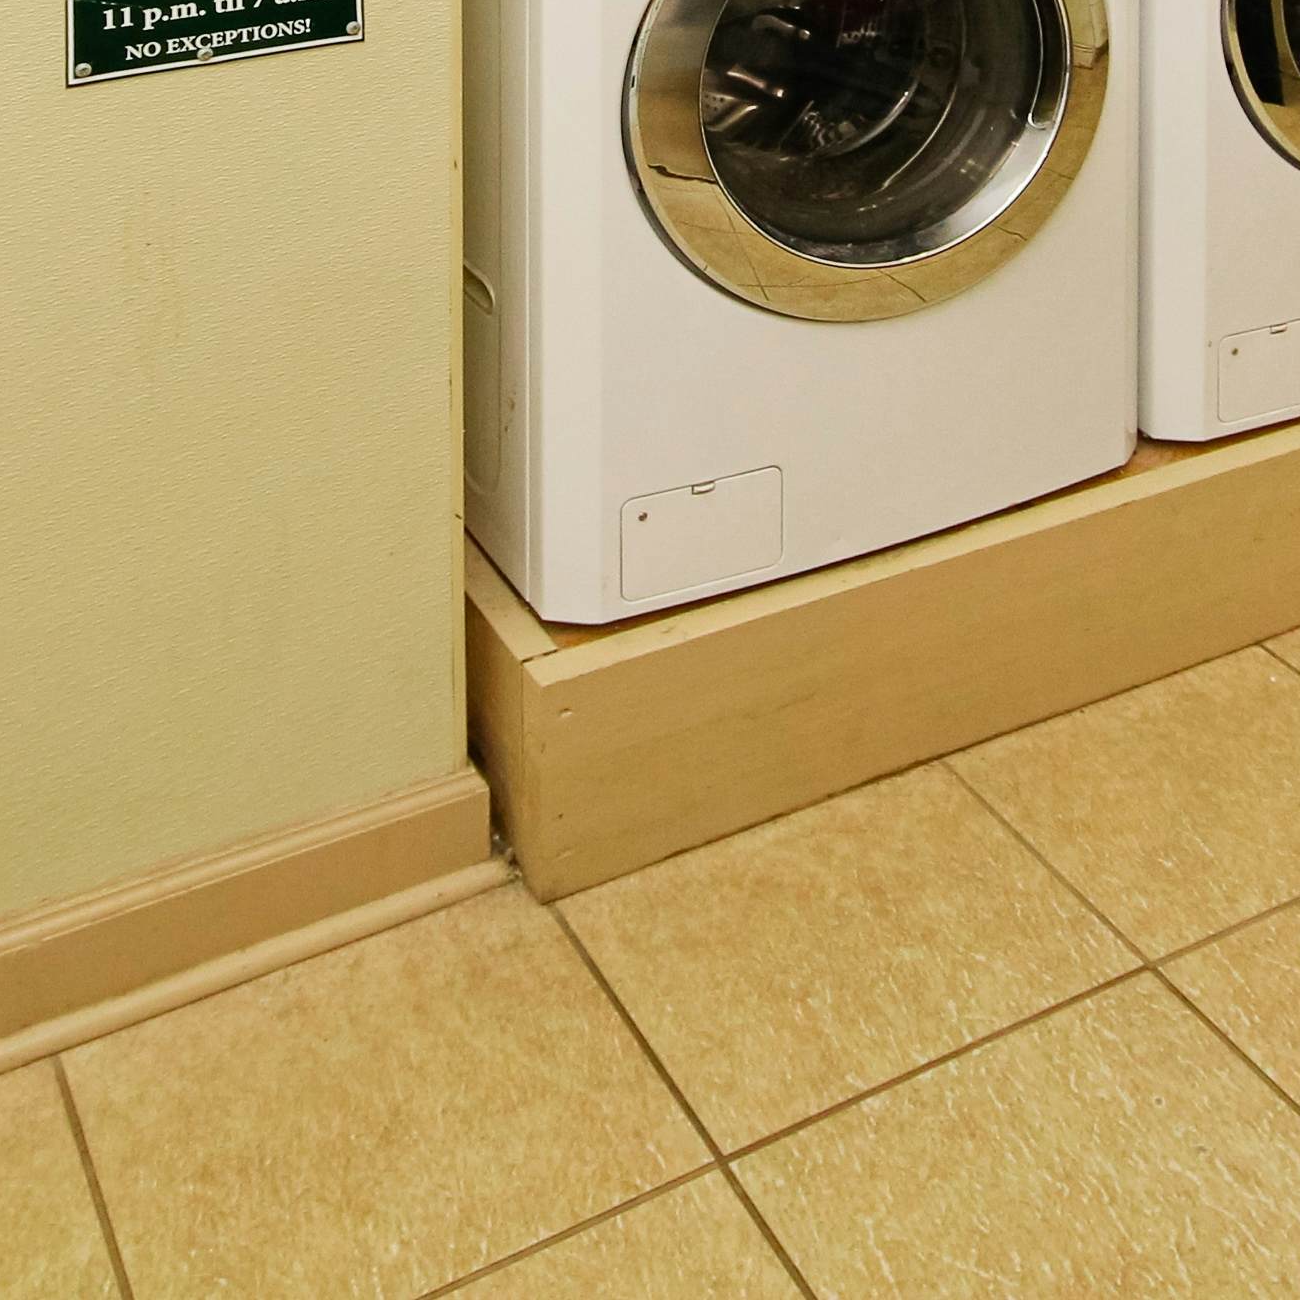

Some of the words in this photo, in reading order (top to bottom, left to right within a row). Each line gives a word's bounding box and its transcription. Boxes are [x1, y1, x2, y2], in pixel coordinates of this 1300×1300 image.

[103, 7, 134, 31] 11
[143, 1, 207, 31] p.m.
[125, 40, 162, 61] NO
[166, 18, 312, 56] EXCEPTIONS!
